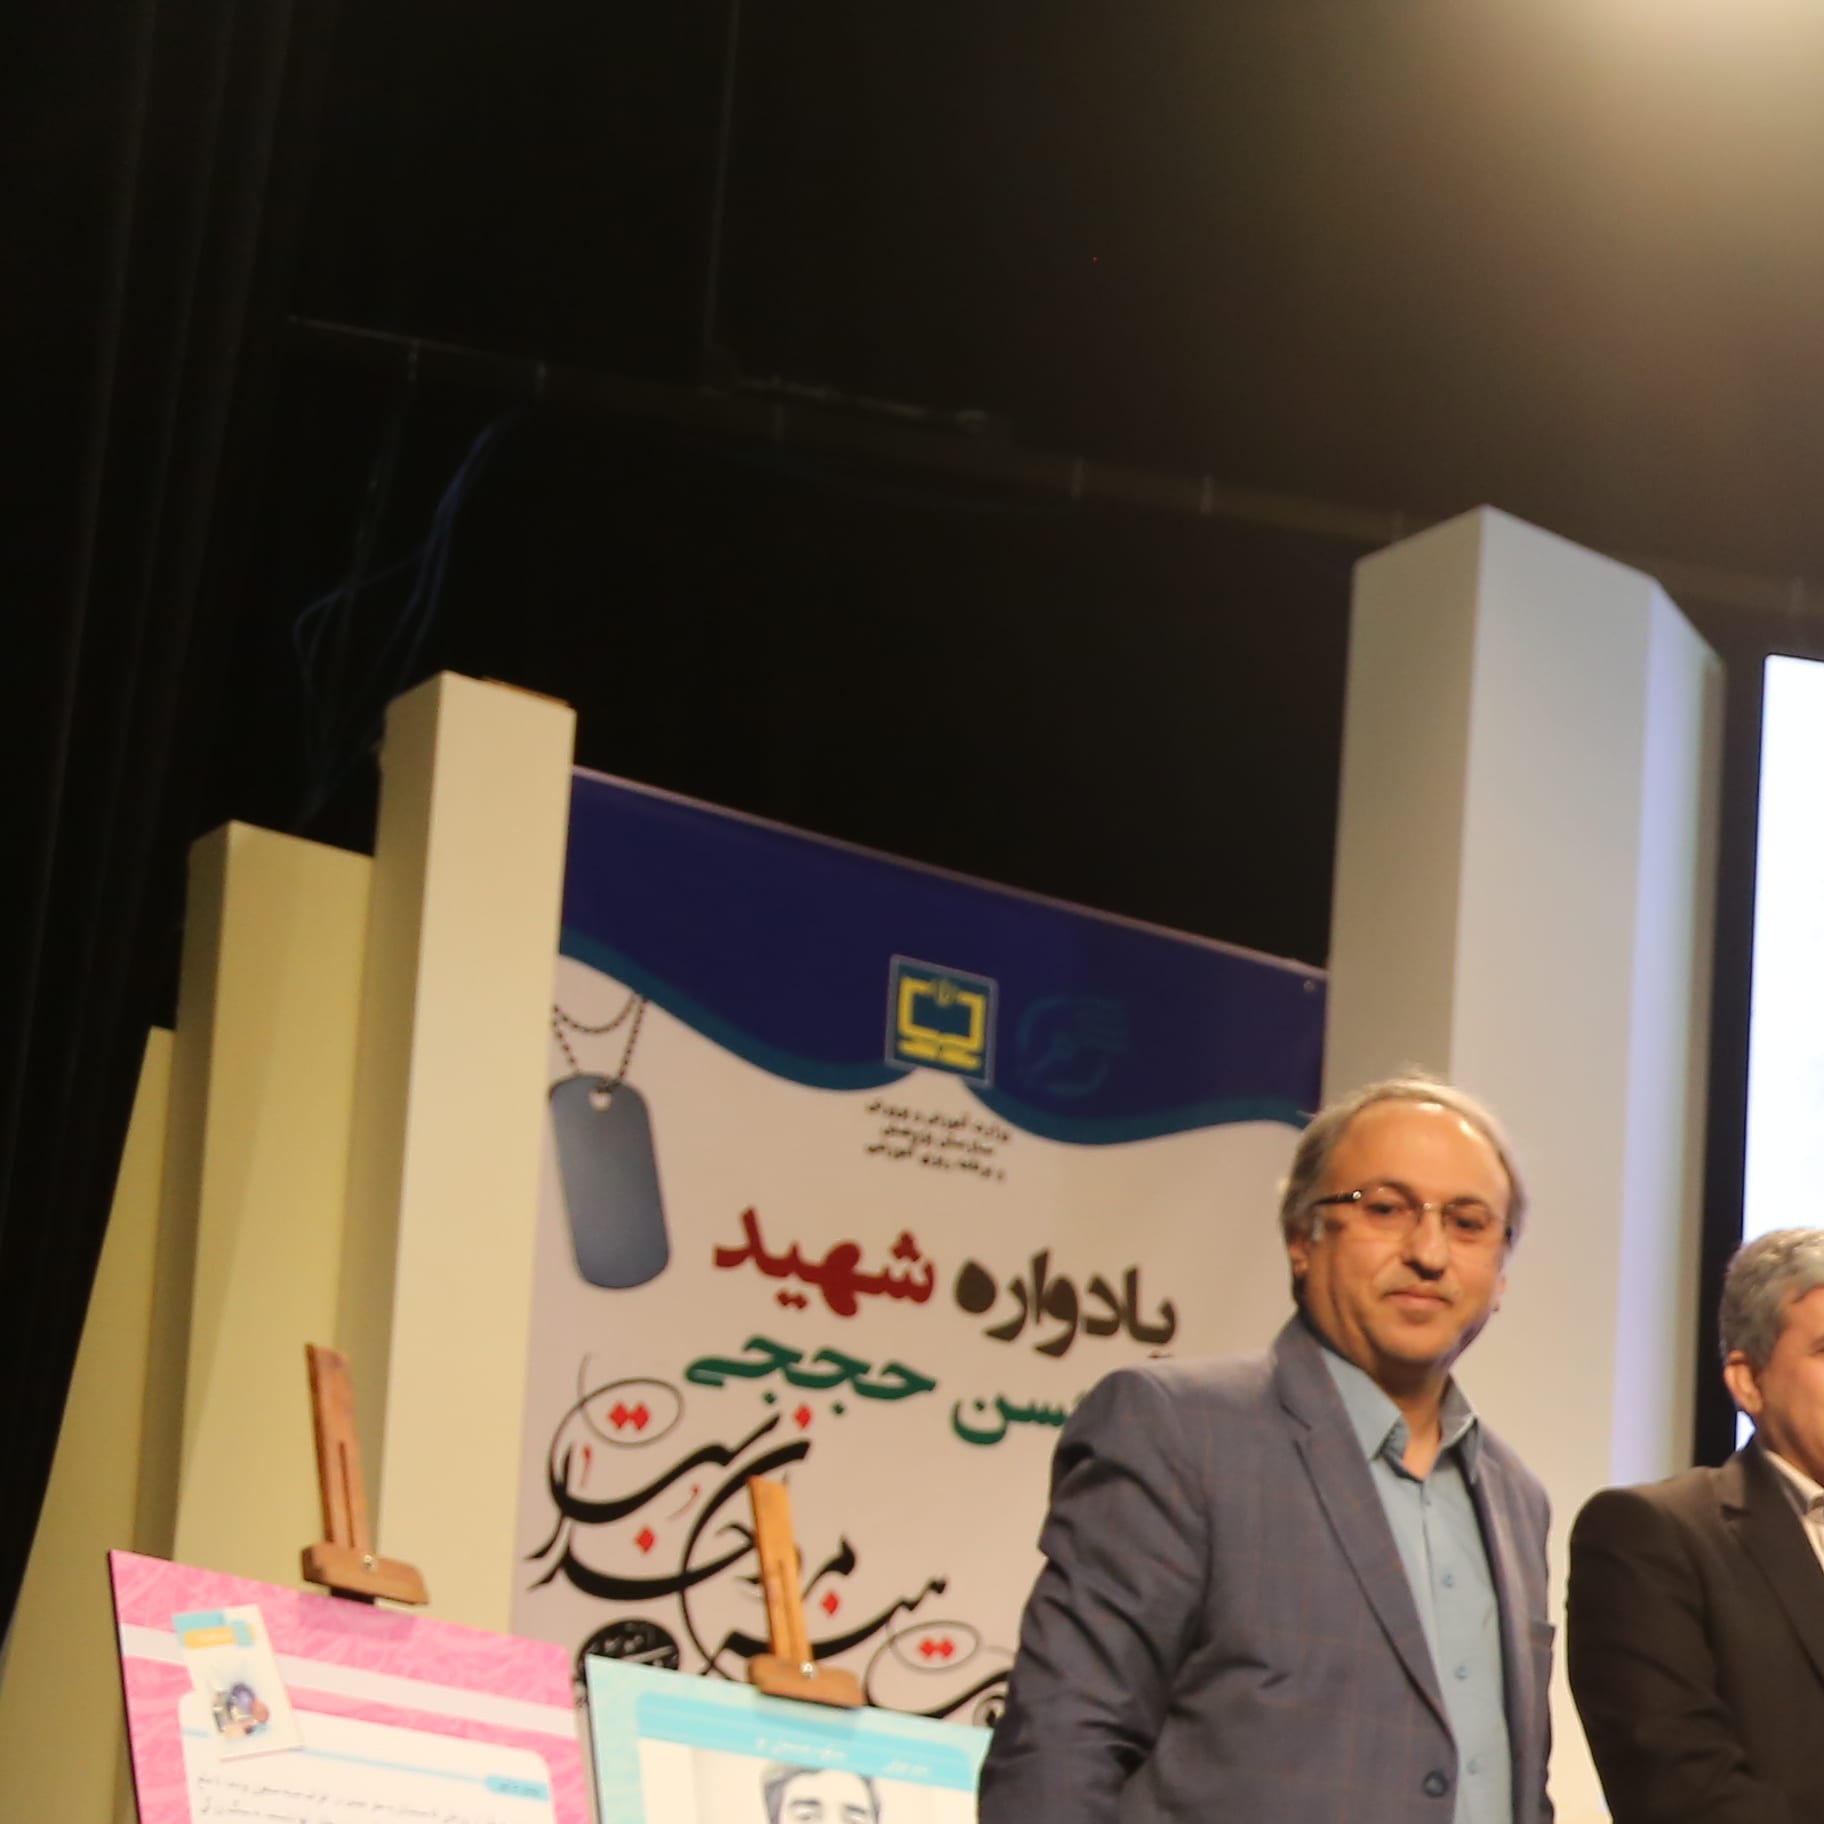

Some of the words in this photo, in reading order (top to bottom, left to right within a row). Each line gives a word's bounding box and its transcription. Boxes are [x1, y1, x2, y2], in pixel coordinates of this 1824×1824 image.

[712, 1204, 938, 1320] شهید
[953, 1247, 1180, 1359] یادواره
[685, 1333, 940, 1418] حججی
